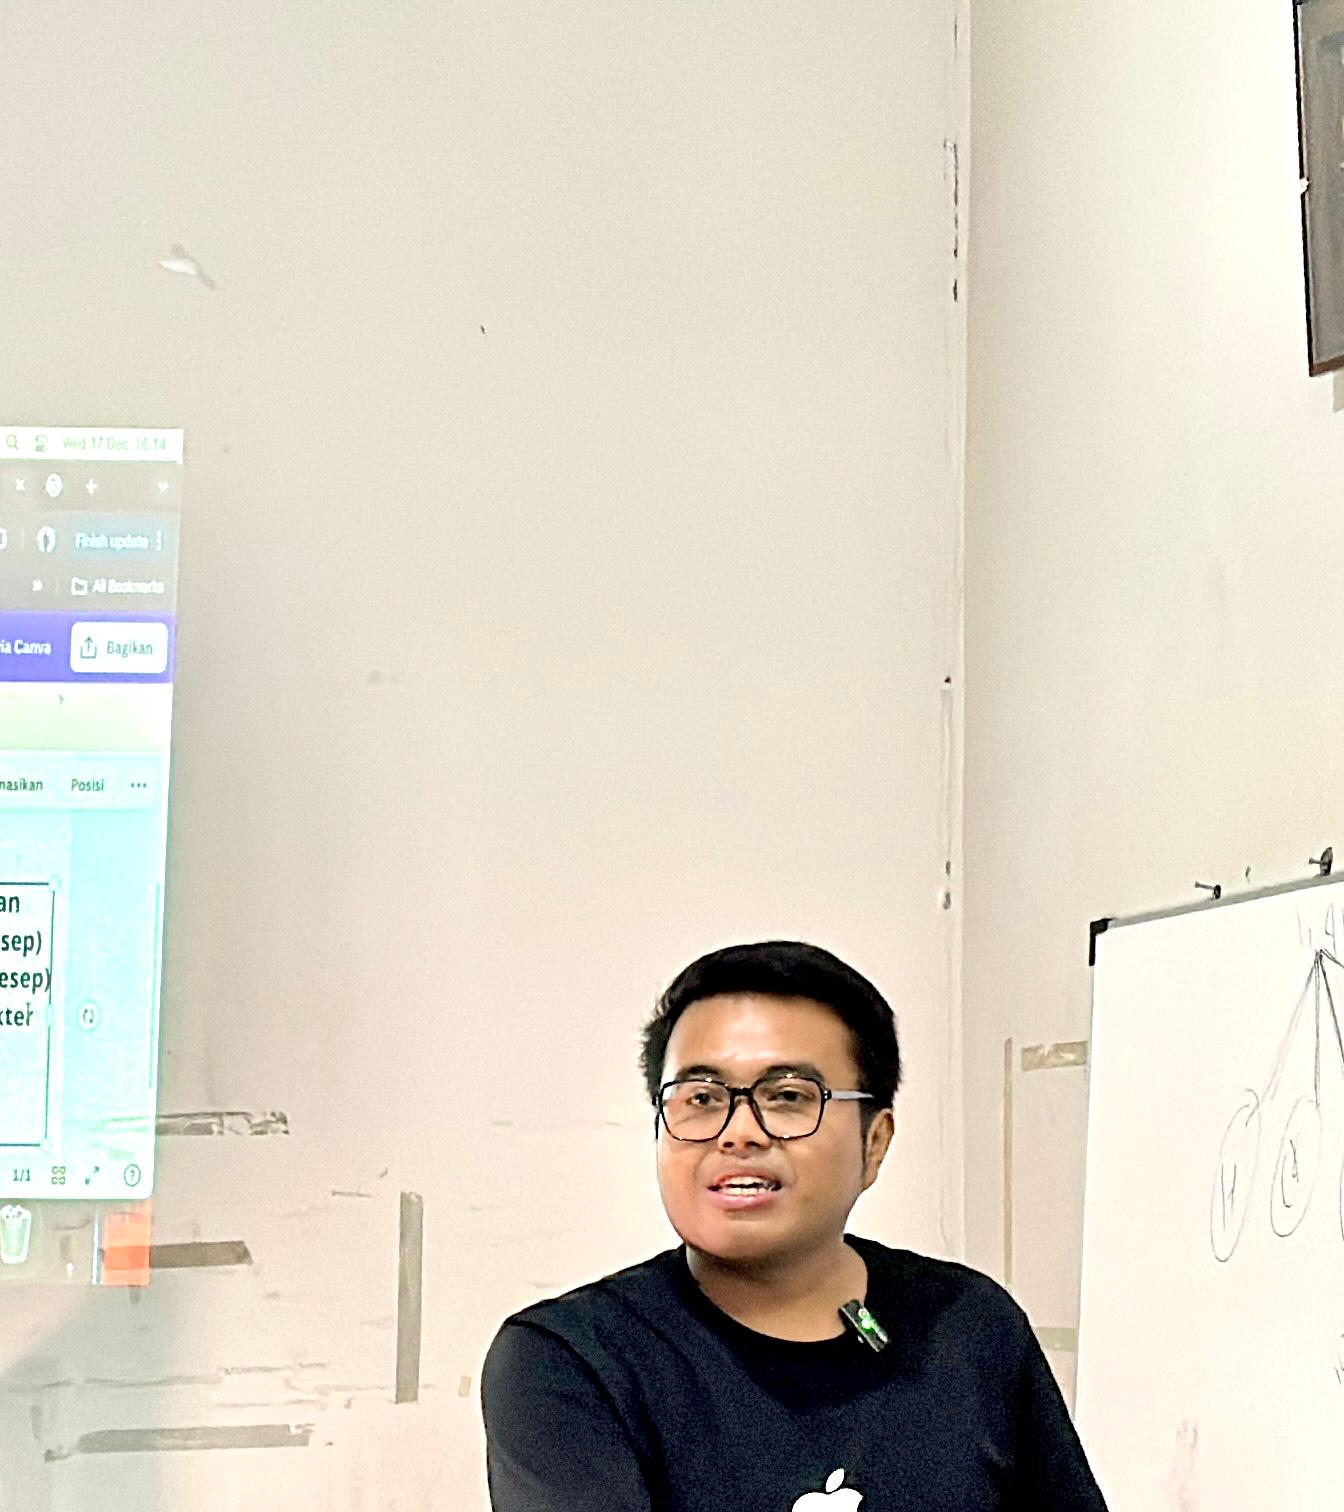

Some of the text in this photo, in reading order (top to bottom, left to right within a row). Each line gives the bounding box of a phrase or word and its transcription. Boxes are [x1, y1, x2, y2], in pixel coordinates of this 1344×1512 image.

[14, 639, 51, 655] Canva
[107, 640, 153, 658] Bagikan
[71, 778, 104, 792] Posisi
[13, 1169, 32, 1182] 1/1
